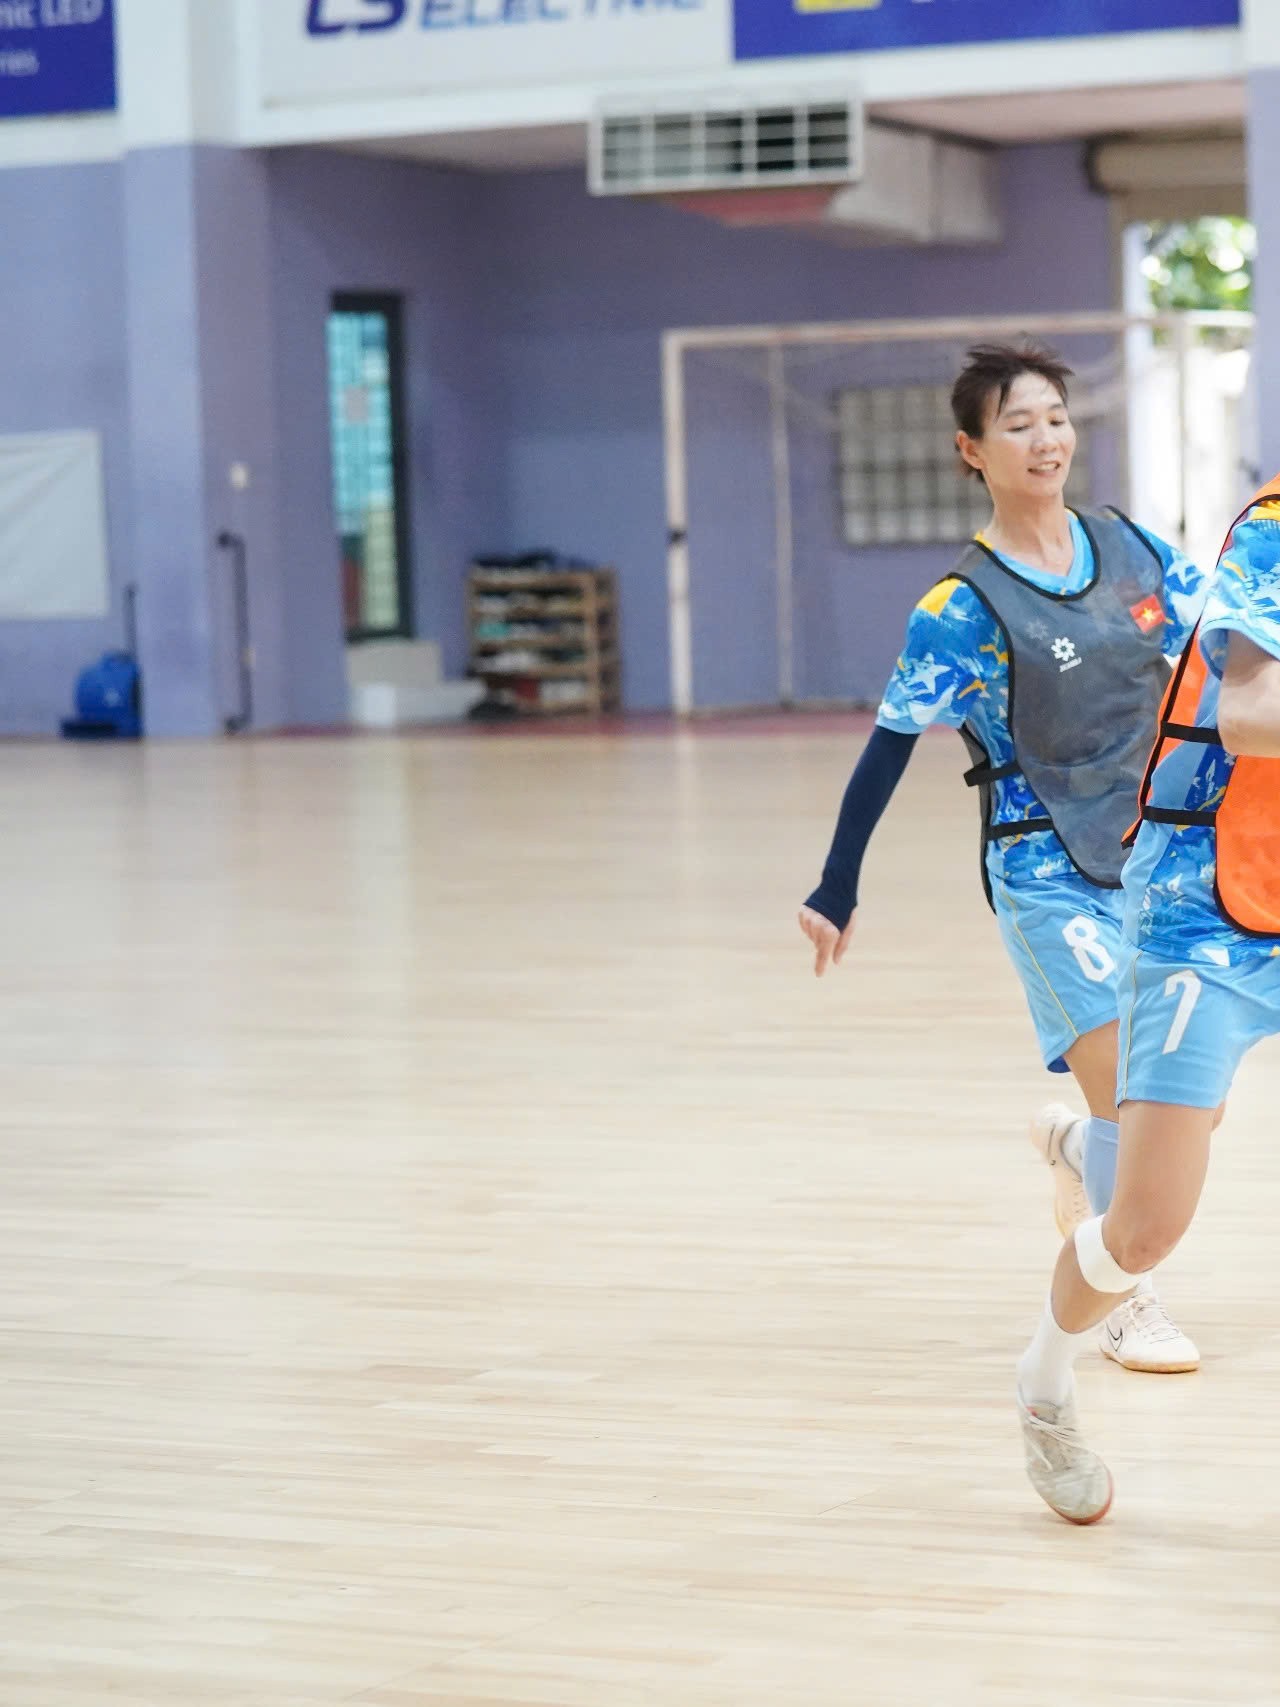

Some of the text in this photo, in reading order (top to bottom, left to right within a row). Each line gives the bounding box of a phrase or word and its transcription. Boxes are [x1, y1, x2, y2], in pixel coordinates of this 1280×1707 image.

[420, 0, 706, 29] ELEC
[1062, 914, 1117, 982] 8
[1162, 969, 1202, 1055] 7
